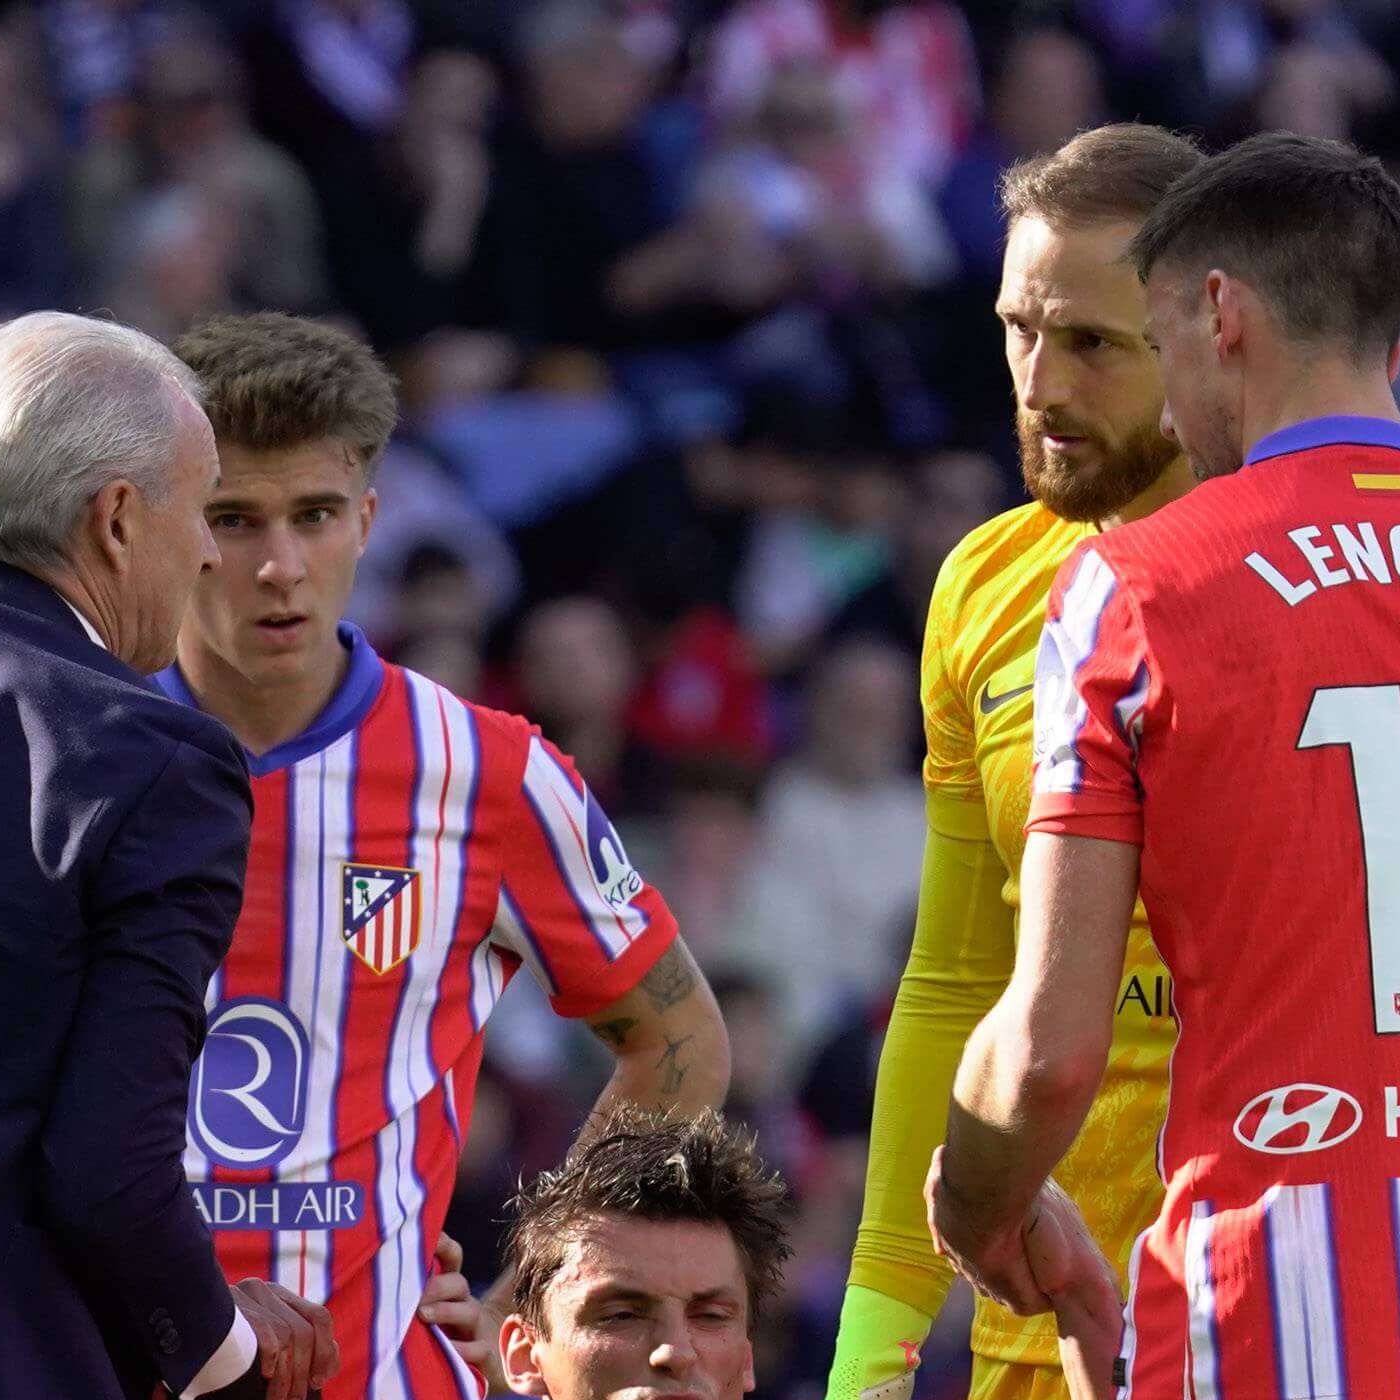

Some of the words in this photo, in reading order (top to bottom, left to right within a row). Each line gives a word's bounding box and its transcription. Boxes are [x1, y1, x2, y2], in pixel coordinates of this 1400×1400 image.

[603, 869, 641, 911] kra
[1116, 974, 1173, 1017] AI
[192, 1187, 280, 1225] ADH
[294, 1186, 357, 1225] AIR
